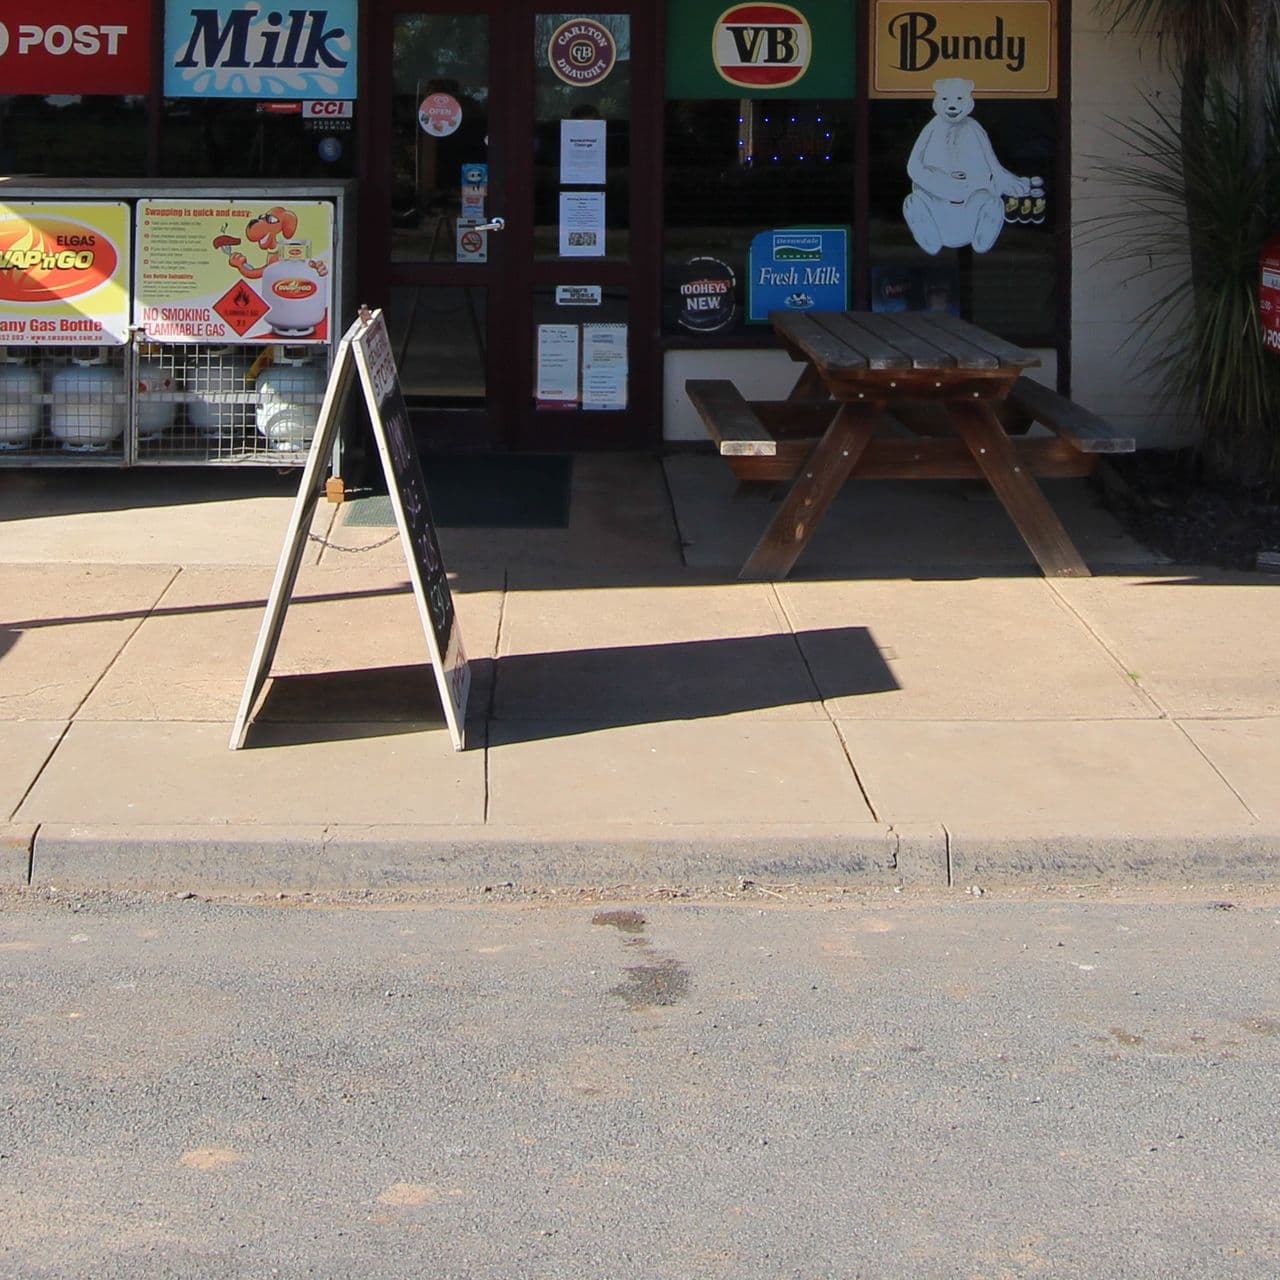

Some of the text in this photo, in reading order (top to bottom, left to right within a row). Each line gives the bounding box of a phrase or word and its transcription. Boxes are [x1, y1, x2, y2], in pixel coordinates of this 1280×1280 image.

[18, 24, 128, 55] POST
[175, 8, 349, 68] Milk
[558, 26, 607, 47] CARLTON
[726, 26, 800, 63] VB
[888, 11, 1025, 72] Bundy
[557, 59, 607, 79] DRAUGHT
[311, 102, 344, 115] CCI
[145, 208, 182, 217] Swapping
[193, 209, 214, 217] quick
[216, 209, 230, 217] and
[57, 235, 96, 246] ELGAS
[759, 265, 840, 286] Fresh Milk
[687, 296, 720, 310] NEW
[144, 308, 210, 321] NO SMOKING
[0, 321, 26, 332] any
[30, 319, 56, 331] Gas
[60, 319, 102, 331] Bottle
[144, 323, 225, 336] FLAMMABLE GAS
